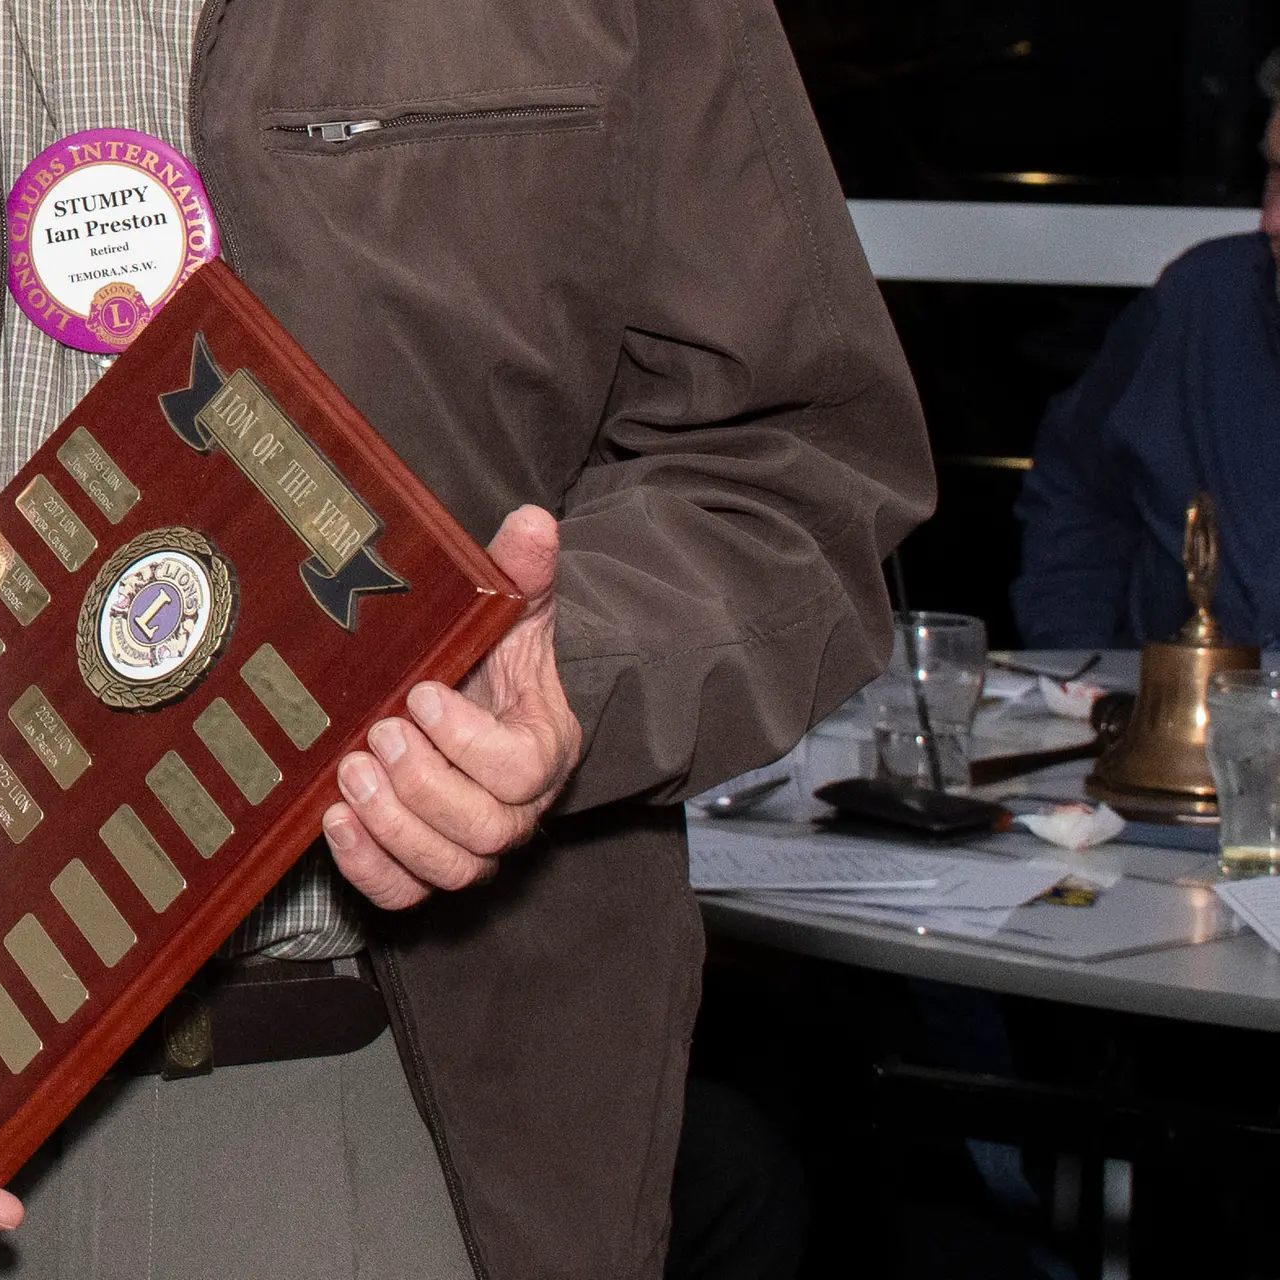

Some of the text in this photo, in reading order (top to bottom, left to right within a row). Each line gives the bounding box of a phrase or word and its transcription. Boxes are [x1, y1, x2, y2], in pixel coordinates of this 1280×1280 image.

[53, 185, 149, 218] STUMPY
[11, 141, 207, 332] LIONS CLUBS INTERNATION
[45, 212, 168, 245] Ian Preston
[90, 242, 130, 257] Retired
[99, 285, 132, 300] LIONS
[109, 304, 131, 328] L
[84, 446, 122, 492] 2016 LION
[210, 385, 361, 559] LION OF THE YEAR
[42, 495, 79, 539] 2017 LION
[11, 566, 34, 593] LION
[163, 563, 198, 610] LIONS
[134, 588, 173, 642] L
[33, 704, 59, 734] 2024
[7, 783, 34, 814] LION
